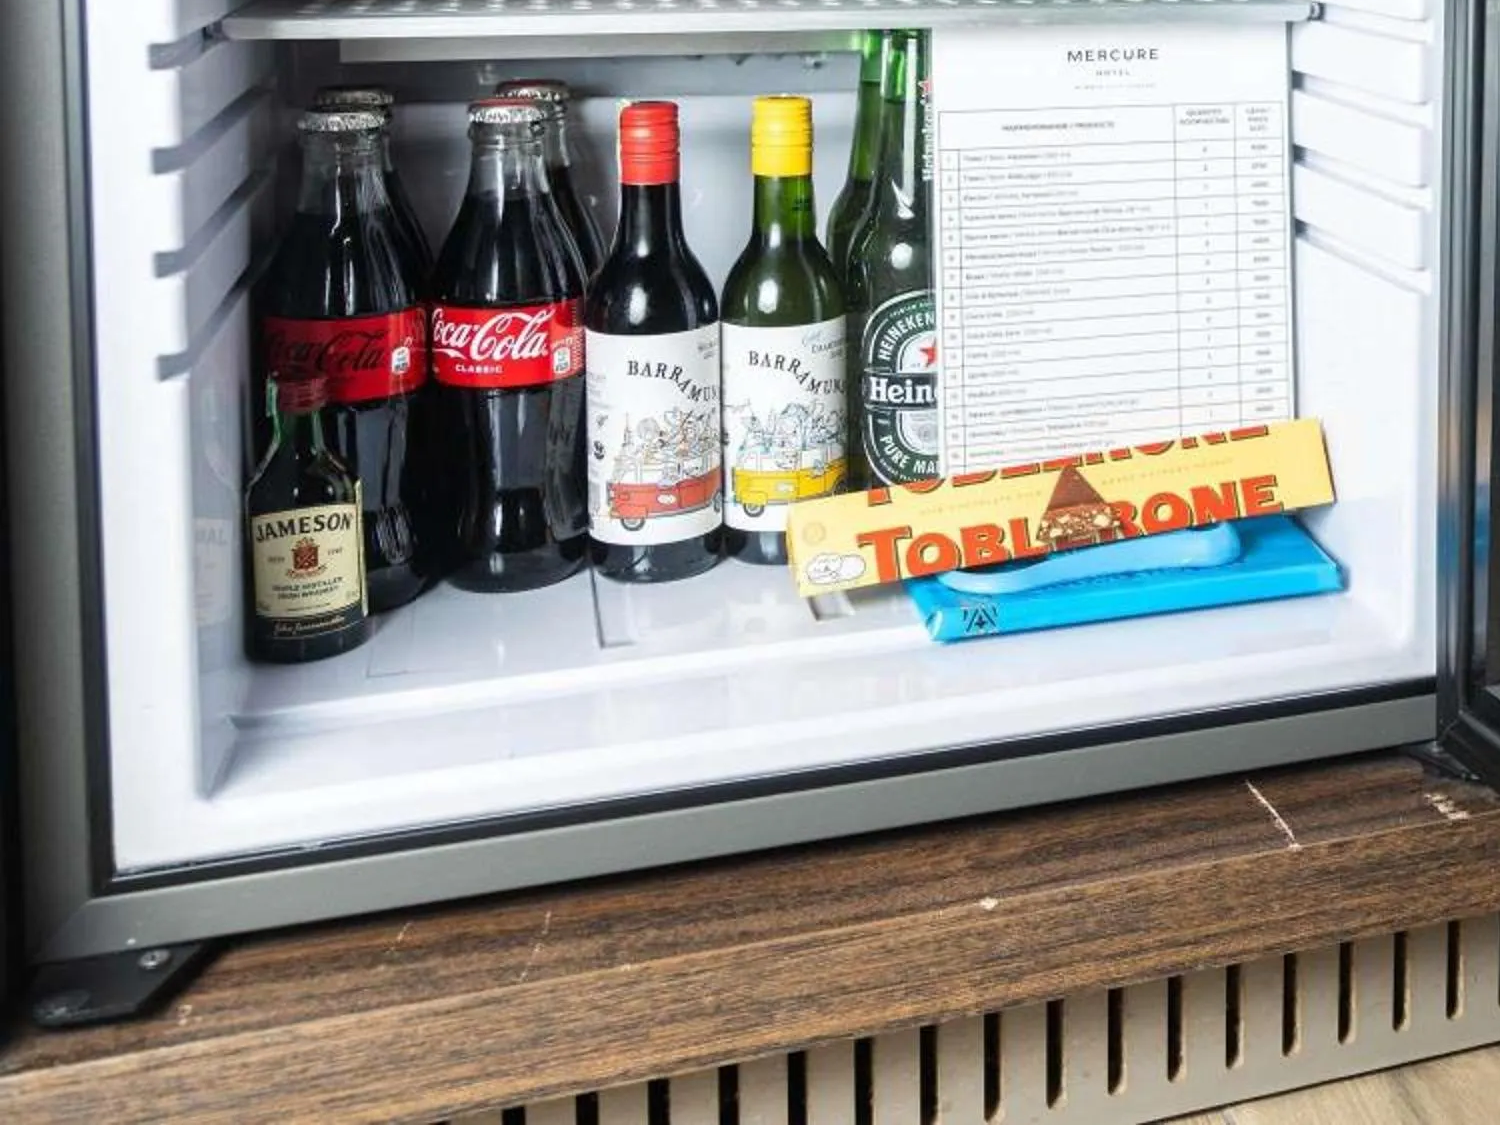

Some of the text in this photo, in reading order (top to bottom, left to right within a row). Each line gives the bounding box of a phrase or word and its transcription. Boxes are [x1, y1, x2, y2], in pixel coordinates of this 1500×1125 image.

[1067, 48, 1160, 63] MERCURE
[877, 311, 936, 362] HEINEKEN
[879, 434, 911, 468] PURE
[255, 512, 352, 544] JAMESON
[856, 474, 1285, 584] TOBLRONE
